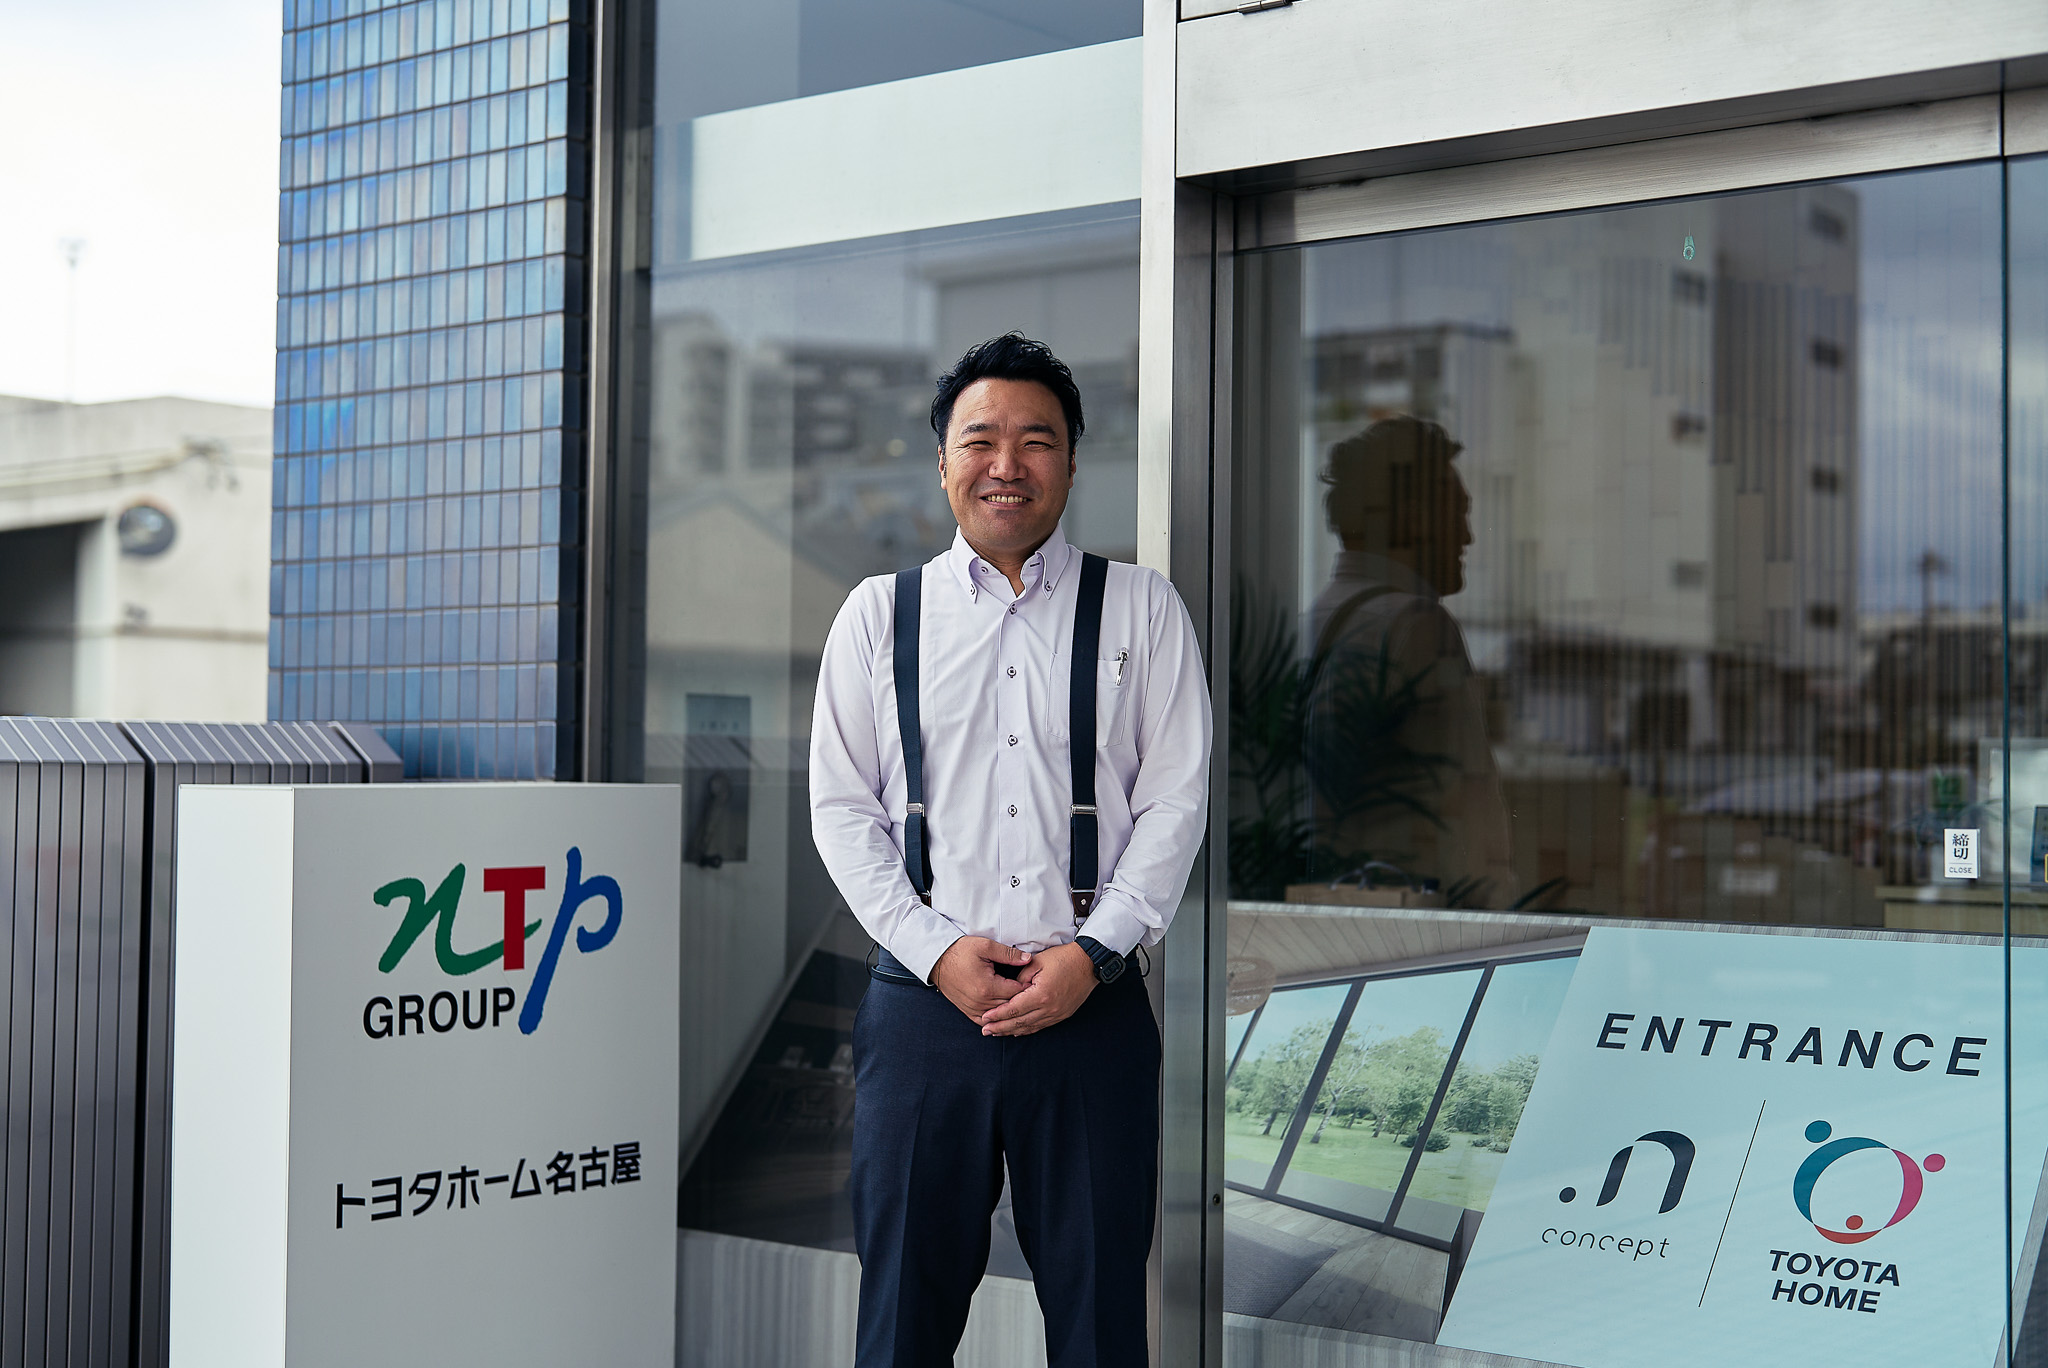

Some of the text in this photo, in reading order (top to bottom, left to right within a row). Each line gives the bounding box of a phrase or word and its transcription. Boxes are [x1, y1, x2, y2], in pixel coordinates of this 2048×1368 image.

[1948, 866, 1972, 874] CLOSE
[362, 986, 517, 1040] GROUP
[1596, 1012, 1989, 1078] ENTRANCE
[335, 1140, 642, 1230] トヨタホーム名古屋
[1541, 1226, 1670, 1262] concept
[1768, 1249, 1901, 1287] TOYOTA
[1771, 1278, 1882, 1314] HOME
